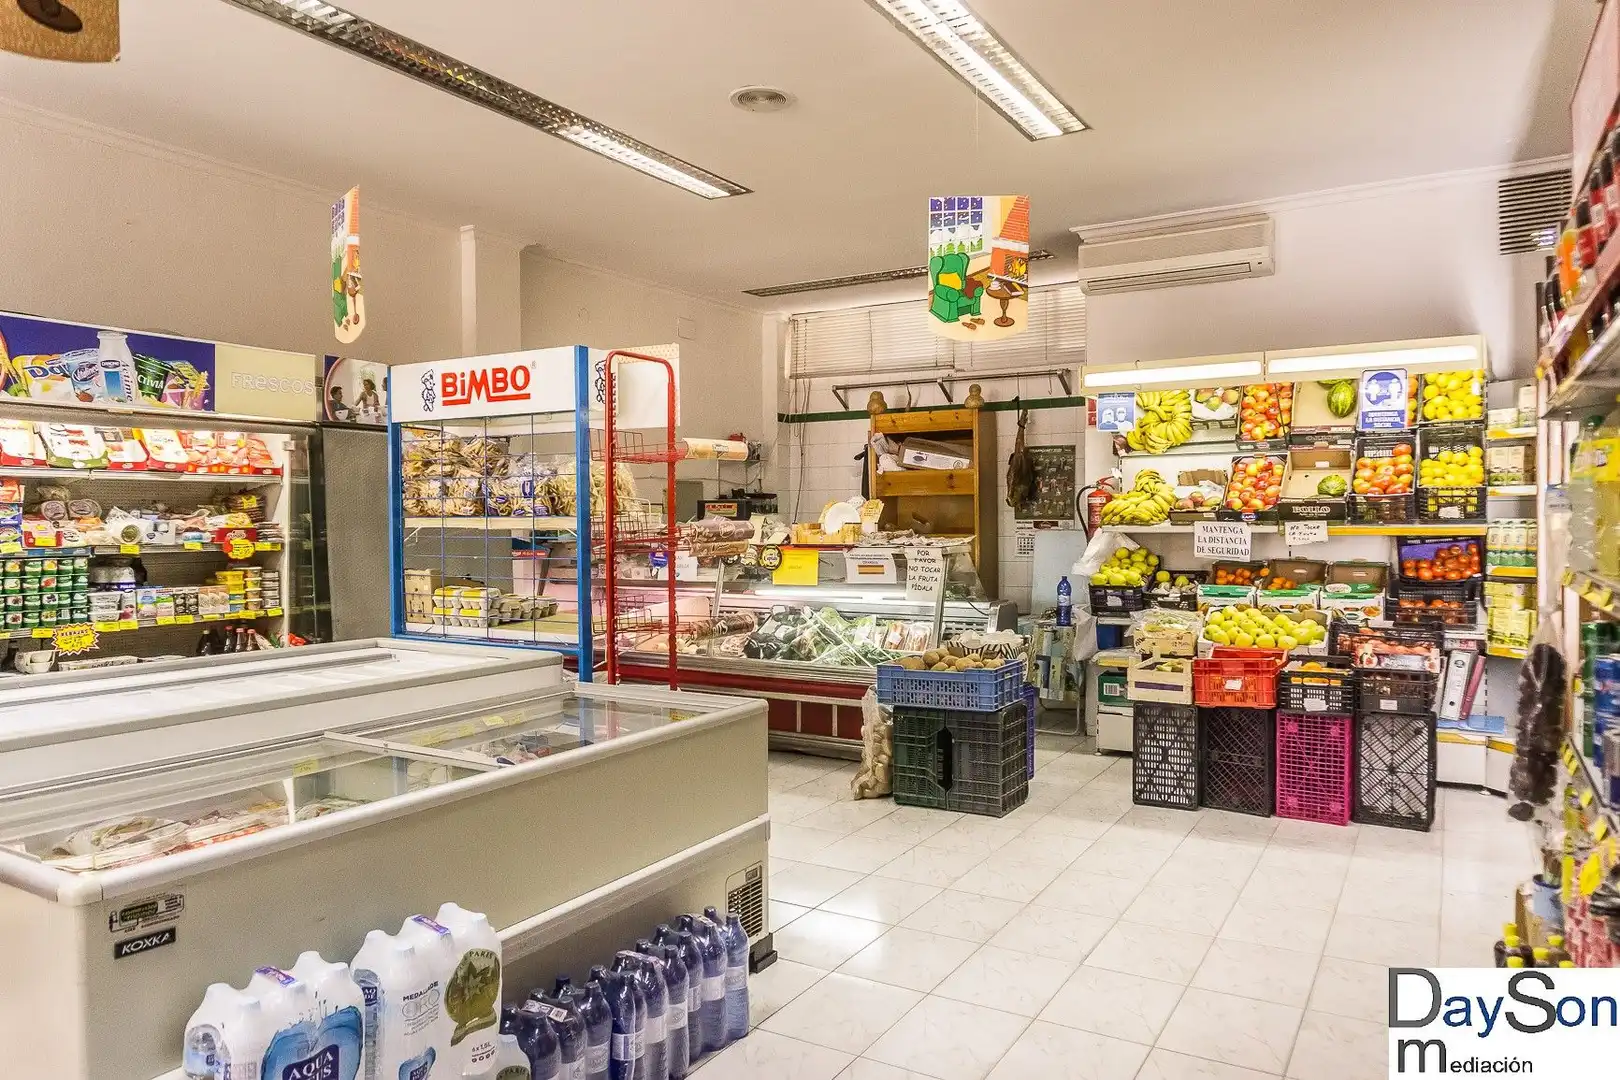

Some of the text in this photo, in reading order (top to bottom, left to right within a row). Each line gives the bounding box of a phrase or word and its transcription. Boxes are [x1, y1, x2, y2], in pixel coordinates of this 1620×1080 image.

[137, 371, 164, 390] CTIVIA
[1202, 525, 1244, 534] MANTENGA
[1197, 535, 1248, 545] LA DISTANCIA
[917, 549, 930, 557] POR
[1207, 546, 1250, 556] SEGURIDAD
[122, 932, 170, 956] KOXKA
[289, 1051, 334, 1080] AQUA
